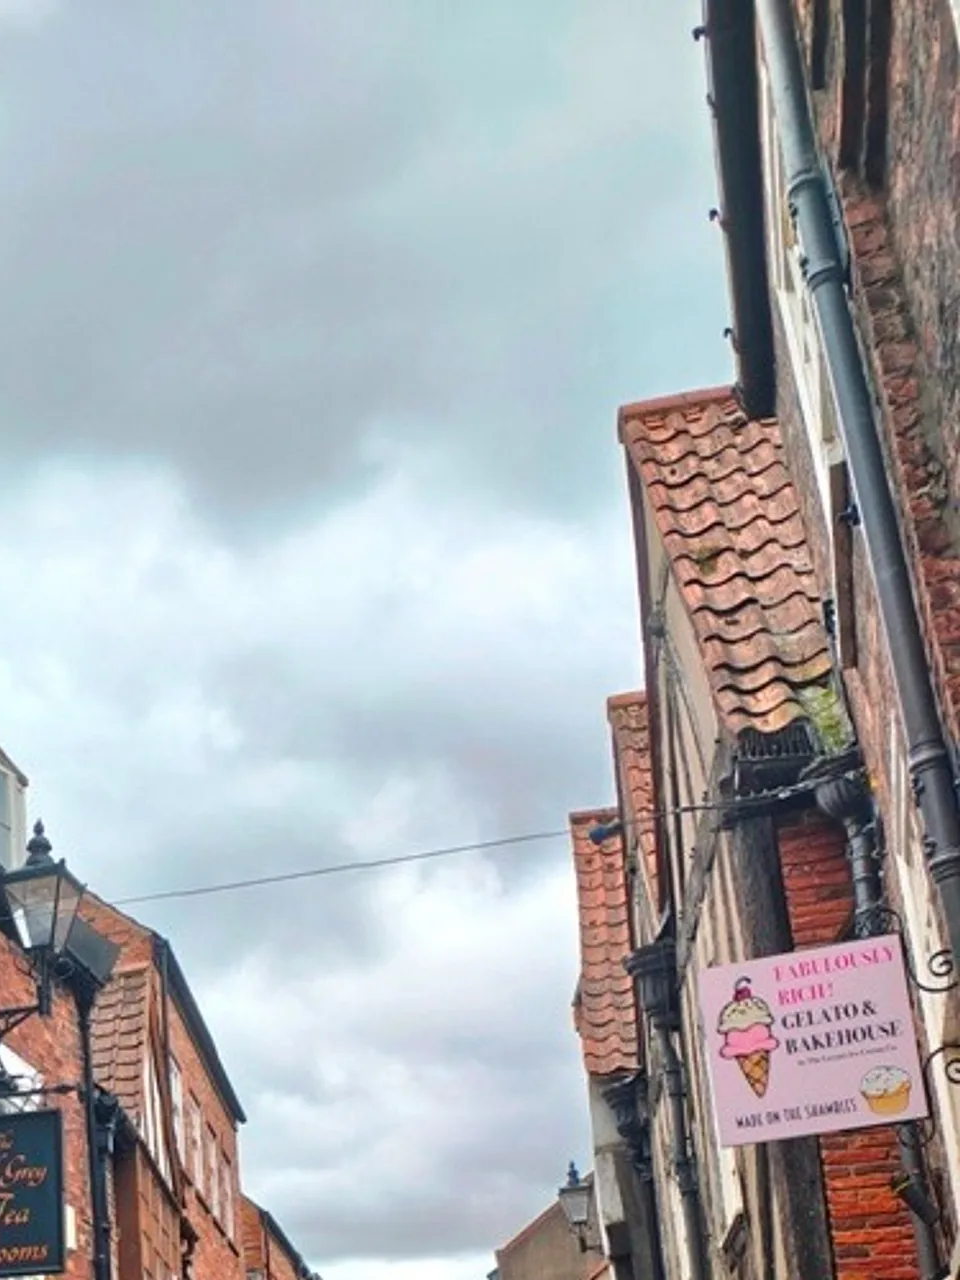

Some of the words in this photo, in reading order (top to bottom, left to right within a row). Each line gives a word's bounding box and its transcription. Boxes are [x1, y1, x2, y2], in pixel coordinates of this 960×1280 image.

[773, 946, 894, 981] FABULOUSLY
[778, 983, 833, 1005] RICH!
[781, 1002, 859, 1030] GELATO
[862, 1000, 877, 1017] &
[785, 1020, 902, 1054] BAKEHOUSE
